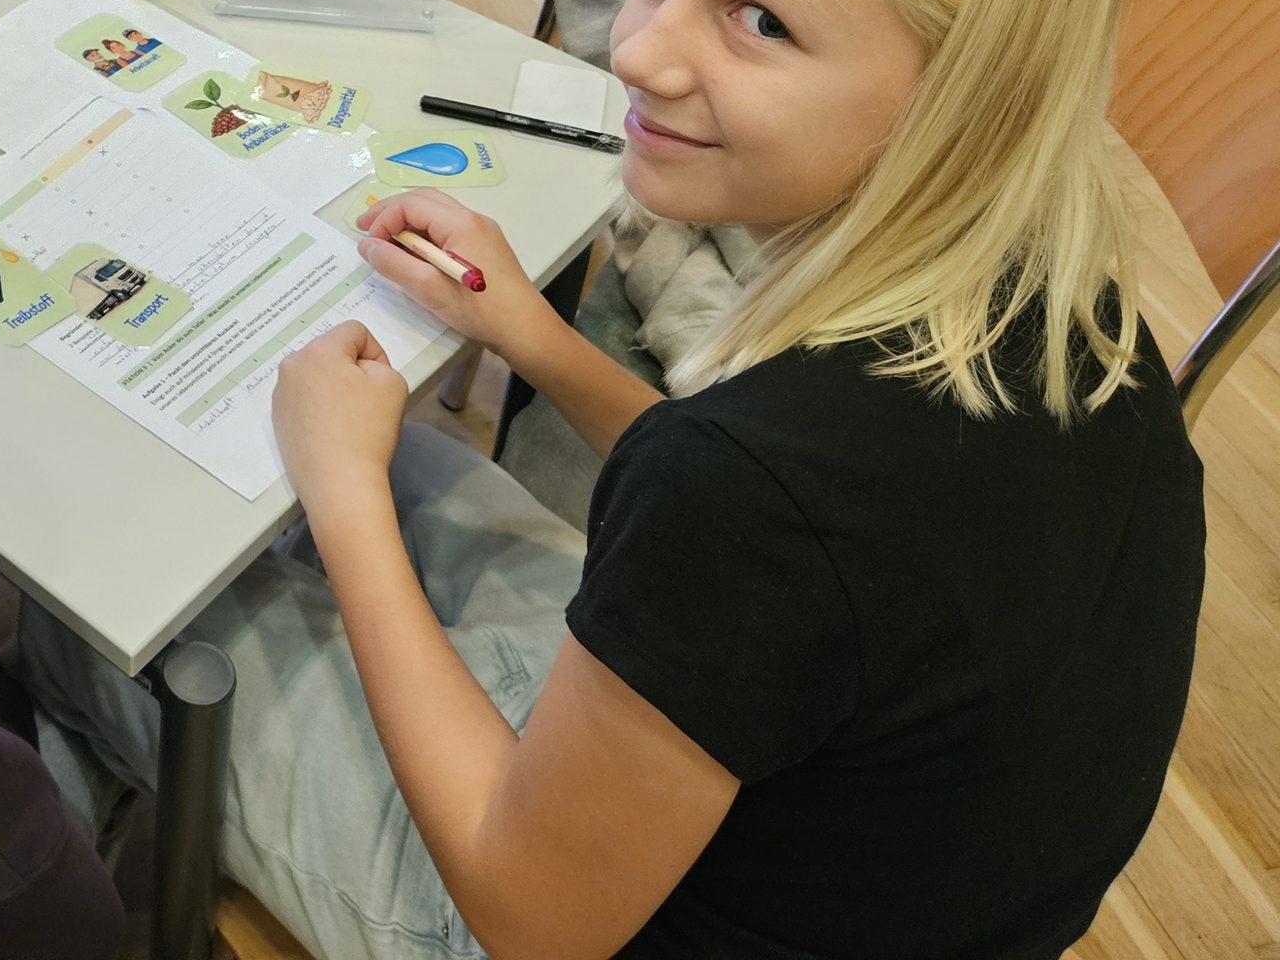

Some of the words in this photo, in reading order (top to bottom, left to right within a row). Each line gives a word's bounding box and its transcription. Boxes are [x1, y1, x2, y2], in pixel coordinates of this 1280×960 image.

[327, 86, 357, 128] Düngemittel
[243, 122, 290, 151] Anbaufläche
[474, 142, 493, 170] Wasser
[2, 292, 56, 329] Treibstoff
[124, 293, 169, 328] Transport
[122, 369, 144, 385] STATION
[152, 353, 164, 362] Vom
[163, 342, 176, 353] Acker
[183, 329, 194, 338] zum
[192, 319, 205, 329] Teller
[142, 383, 162, 399] Aufgabe
